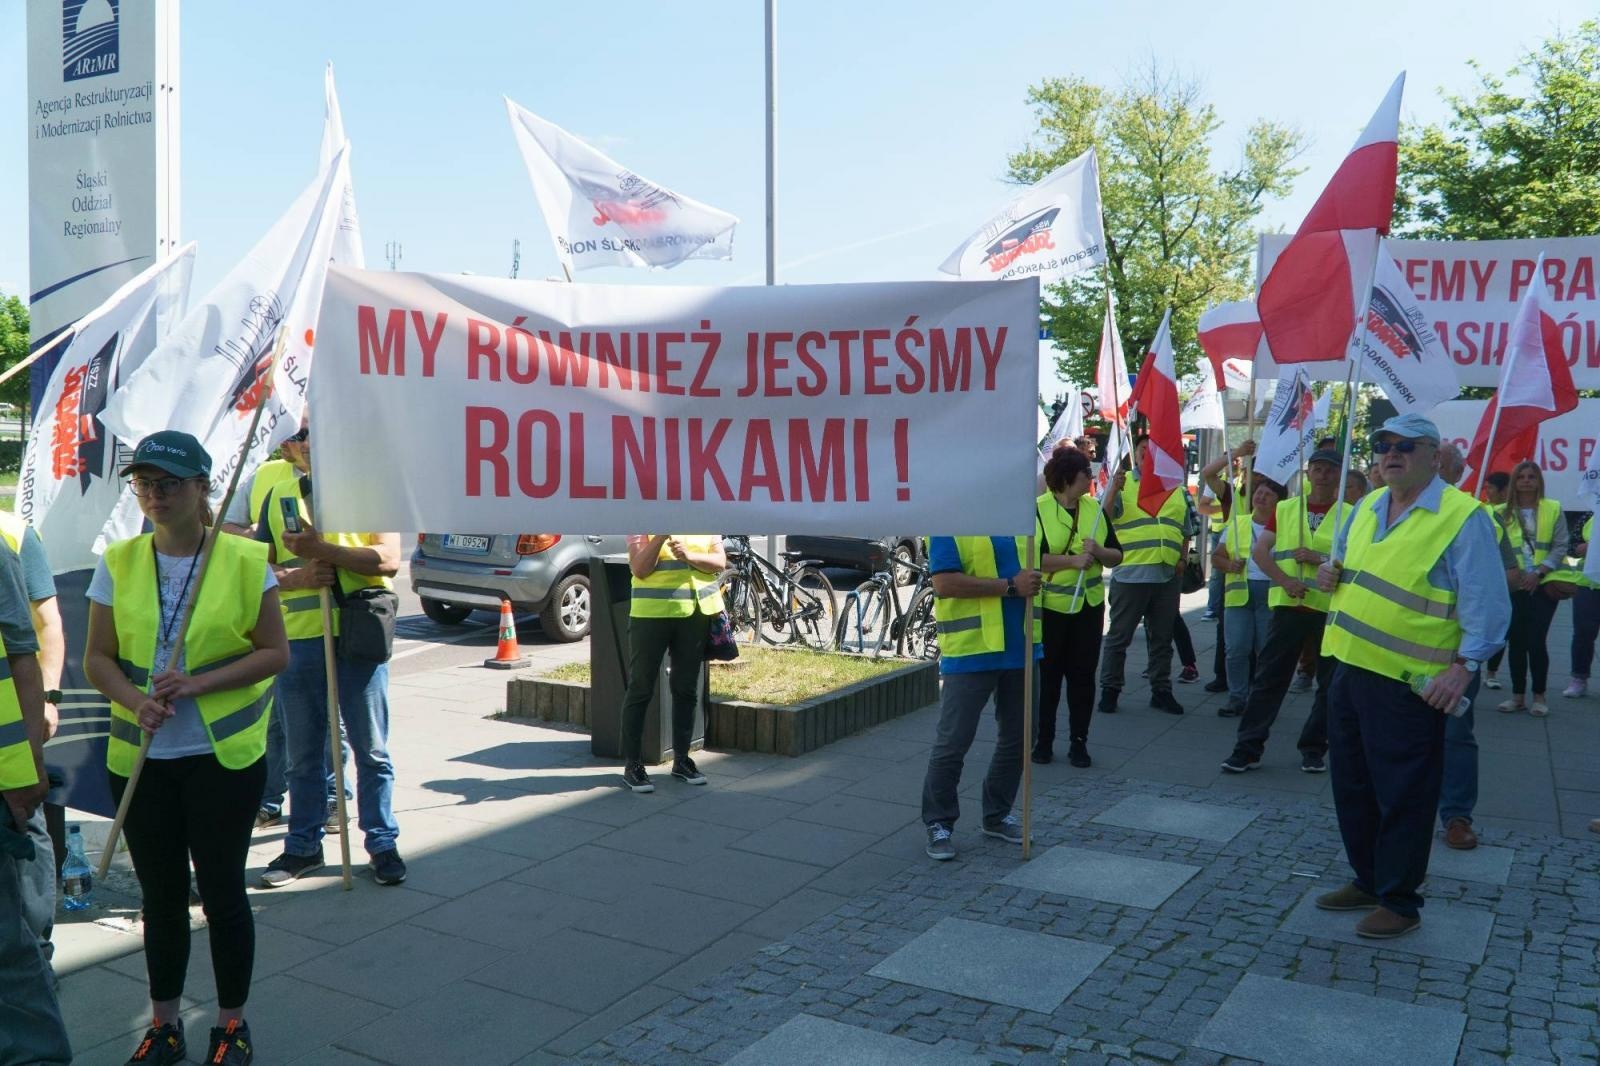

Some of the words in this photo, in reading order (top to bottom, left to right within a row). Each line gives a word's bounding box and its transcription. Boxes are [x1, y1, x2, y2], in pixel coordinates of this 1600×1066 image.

[73, 53, 117, 77] ARiMR
[35, 96, 72, 119] Agencja
[75, 81, 152, 107] Restrukturyzacji
[35, 125, 39, 139] i
[41, 115, 101, 138] Modernizacji
[104, 111, 152, 129] Rolnictwa
[76, 169, 108, 191] Śląski
[72, 193, 112, 213] Oddział
[64, 217, 122, 239] Regionalny
[1394, 258, 1498, 302] EMY
[357, 305, 449, 378] MY
[466, 316, 722, 399] RÓWNIEŻ
[737, 315, 1009, 398] JESTEŚMY
[464, 406, 870, 503] ROLNIKAMI
[894, 417, 911, 501] !
